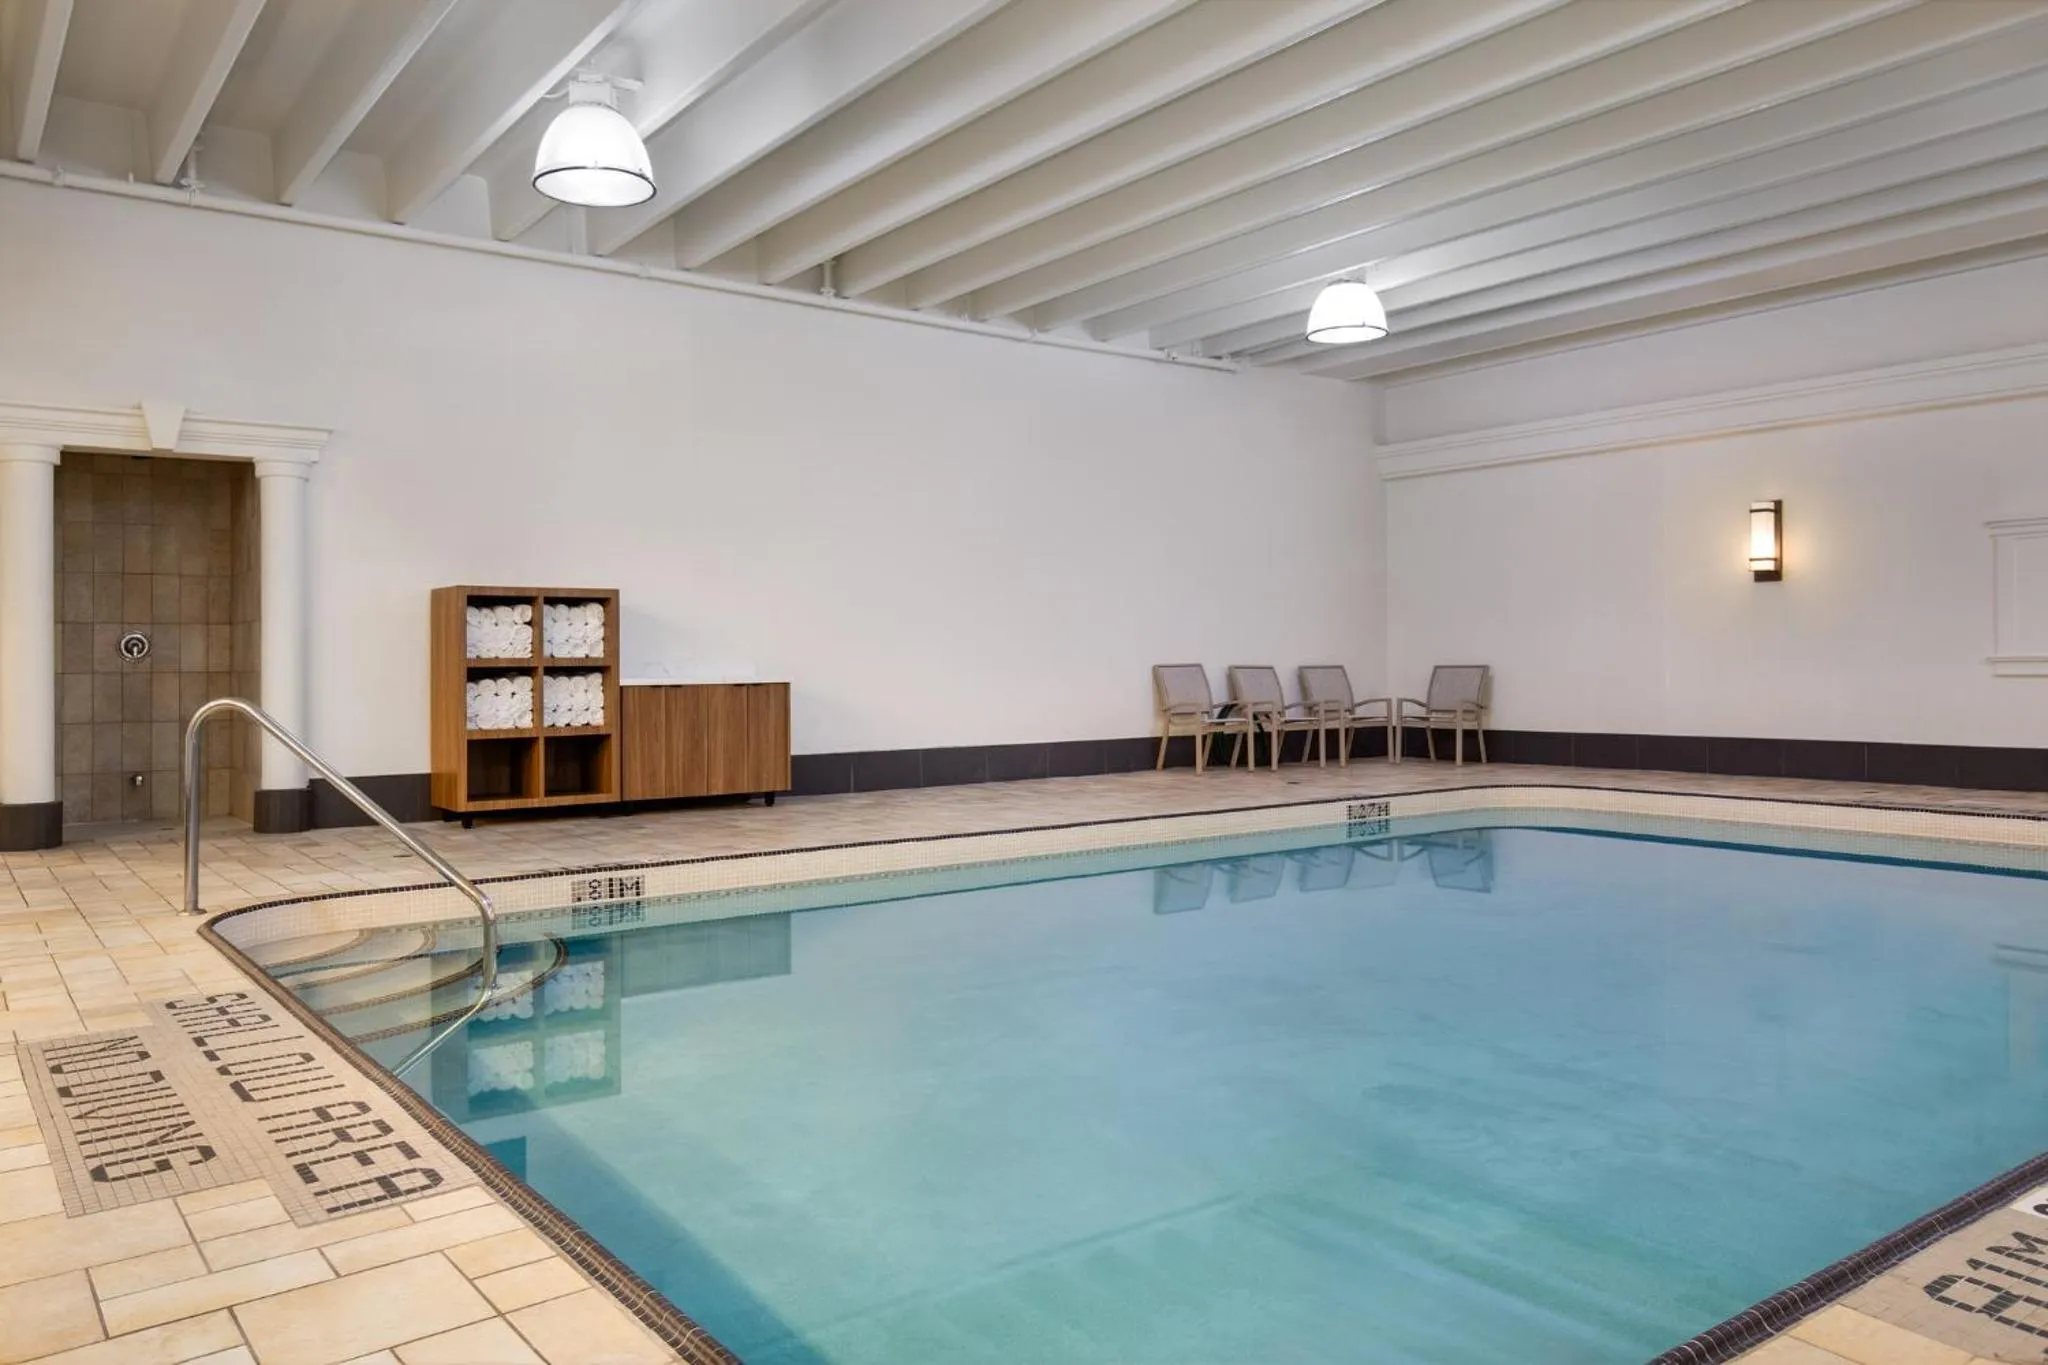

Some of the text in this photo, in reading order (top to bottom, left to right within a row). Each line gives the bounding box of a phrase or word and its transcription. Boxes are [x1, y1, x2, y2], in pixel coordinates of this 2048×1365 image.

[43, 1035, 217, 1183] NO DIVING
[164, 992, 444, 1214] SHALLOW AREA
[1923, 1231, 2048, 1355] 81M
